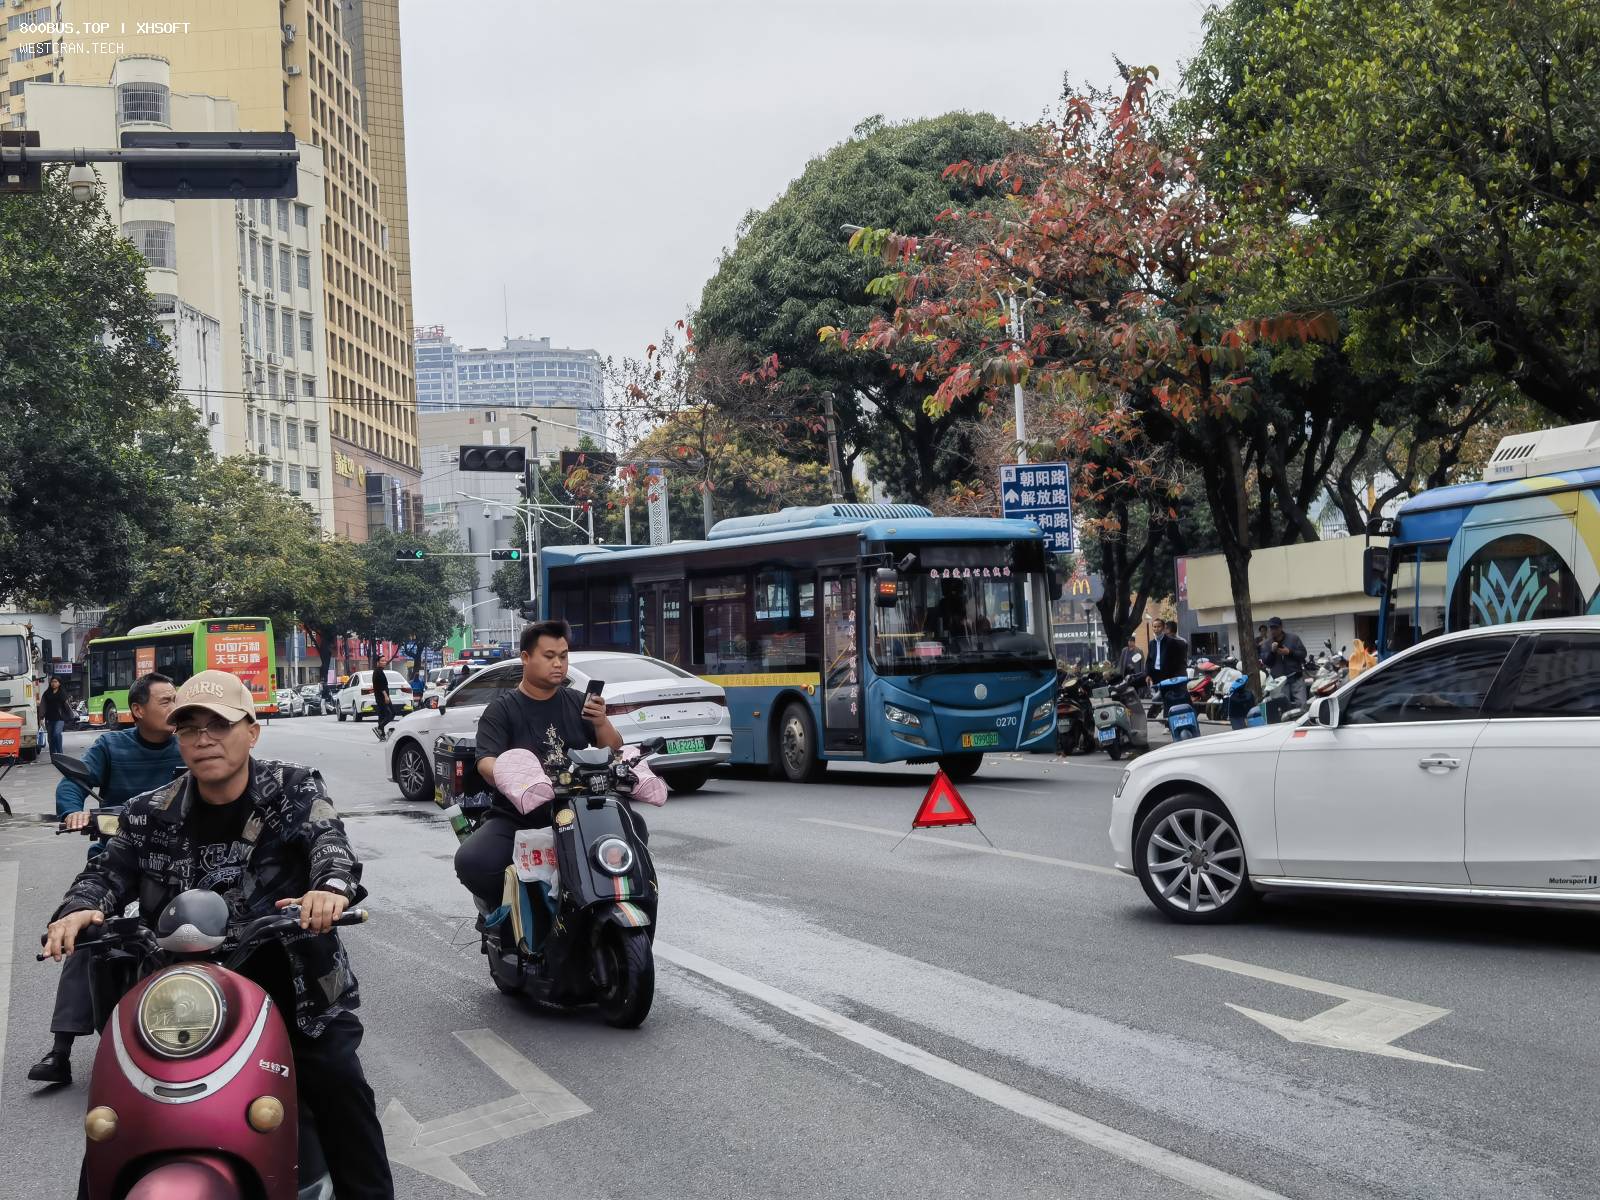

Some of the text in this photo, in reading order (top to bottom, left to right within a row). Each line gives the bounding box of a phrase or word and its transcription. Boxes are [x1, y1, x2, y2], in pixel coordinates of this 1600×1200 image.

[1020, 469, 1066, 487] 朝阳路
[1021, 488, 1068, 507] 解放路
[995, 716, 1017, 728] 0270
[1548, 877, 1587, 886] Motorsport
